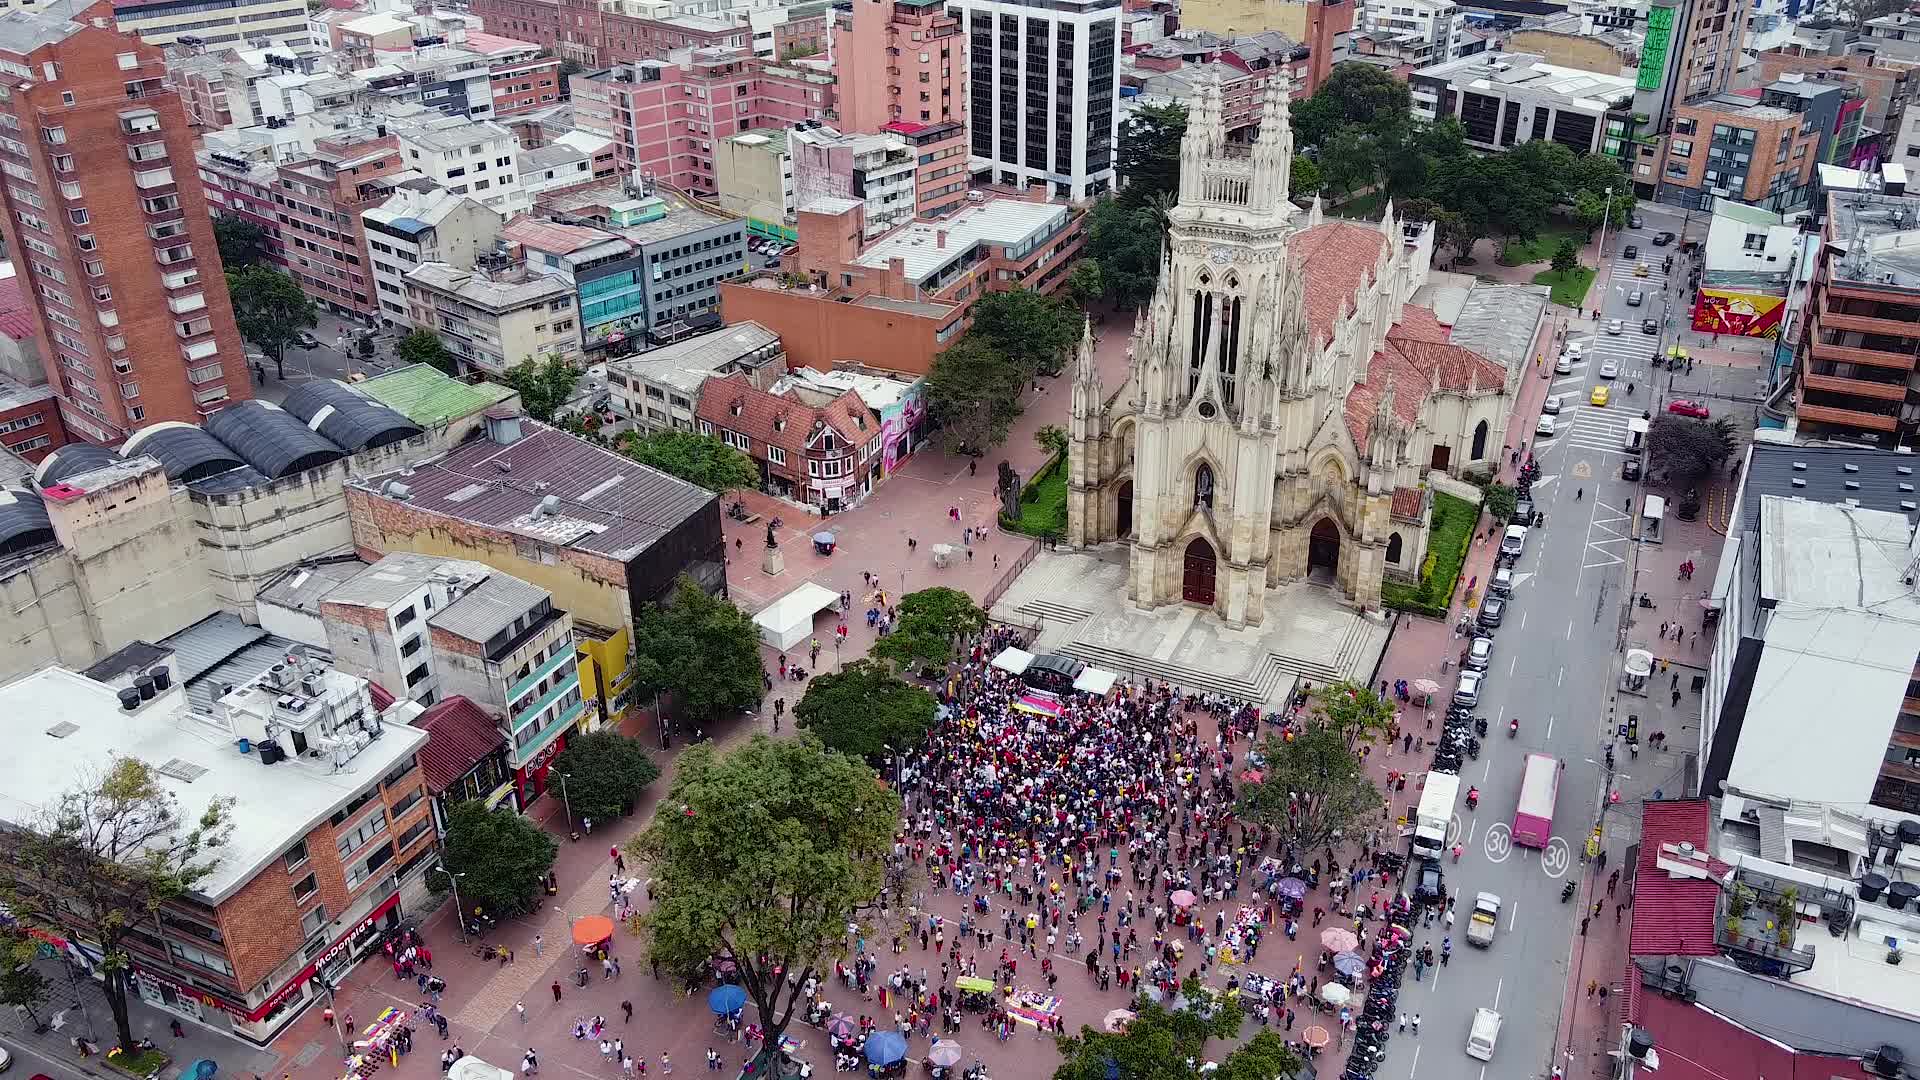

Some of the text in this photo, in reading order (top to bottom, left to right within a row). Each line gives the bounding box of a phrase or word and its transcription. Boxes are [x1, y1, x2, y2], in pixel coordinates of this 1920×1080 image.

[1619, 367, 1643, 379] OLAR
[1487, 831, 1509, 854] 30
[1544, 846, 1566, 869] 30
[314, 917, 373, 971] McDonald's
[269, 982, 297, 1008] POSTRES
